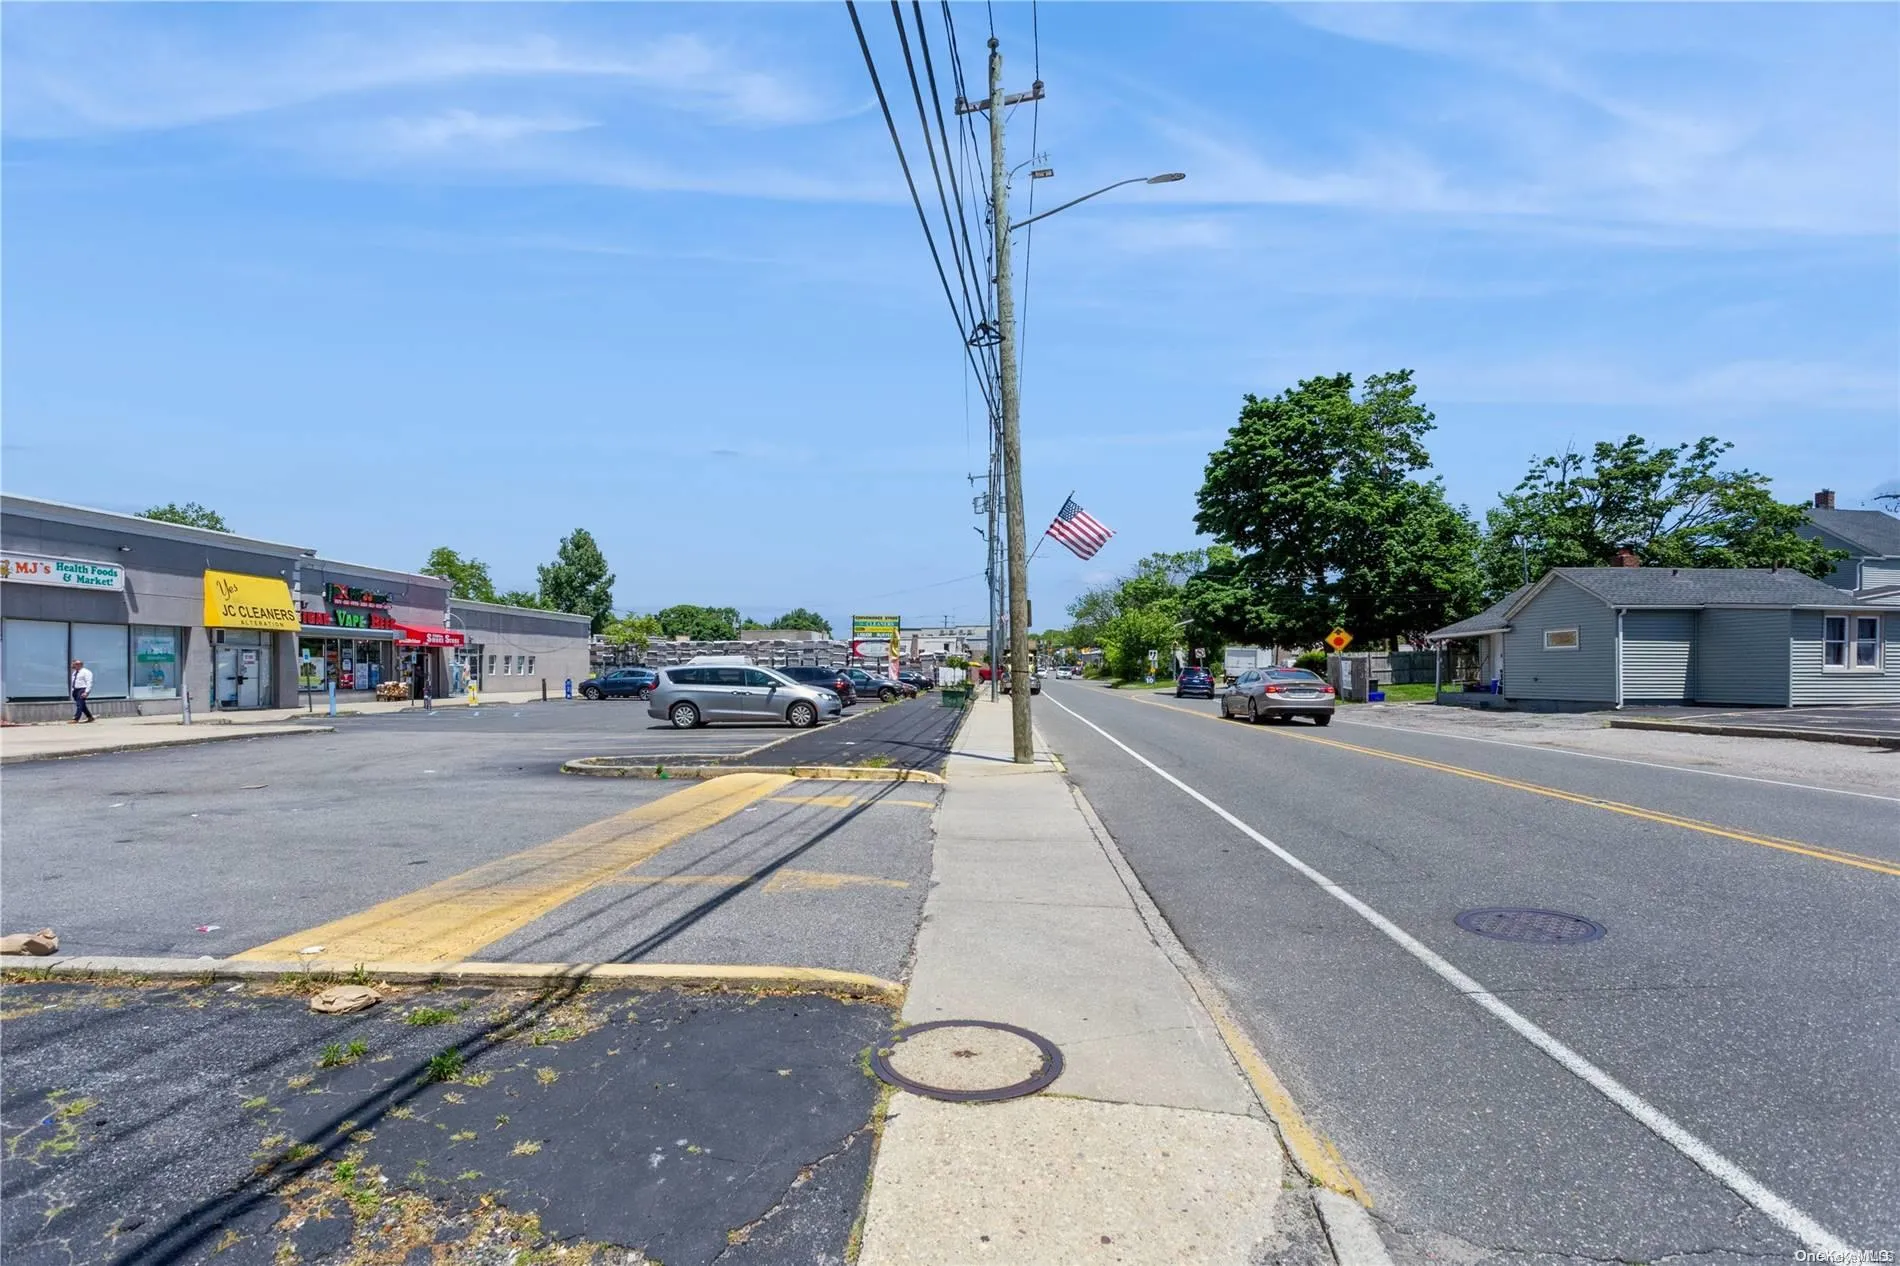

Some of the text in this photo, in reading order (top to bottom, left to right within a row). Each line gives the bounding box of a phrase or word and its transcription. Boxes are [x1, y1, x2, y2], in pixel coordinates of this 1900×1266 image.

[15, 562, 118, 577] MJ's Health Foods
[62, 573, 113, 586] & Market!
[216, 579, 238, 601] Yes
[222, 604, 296, 621] JC CLEANERS
